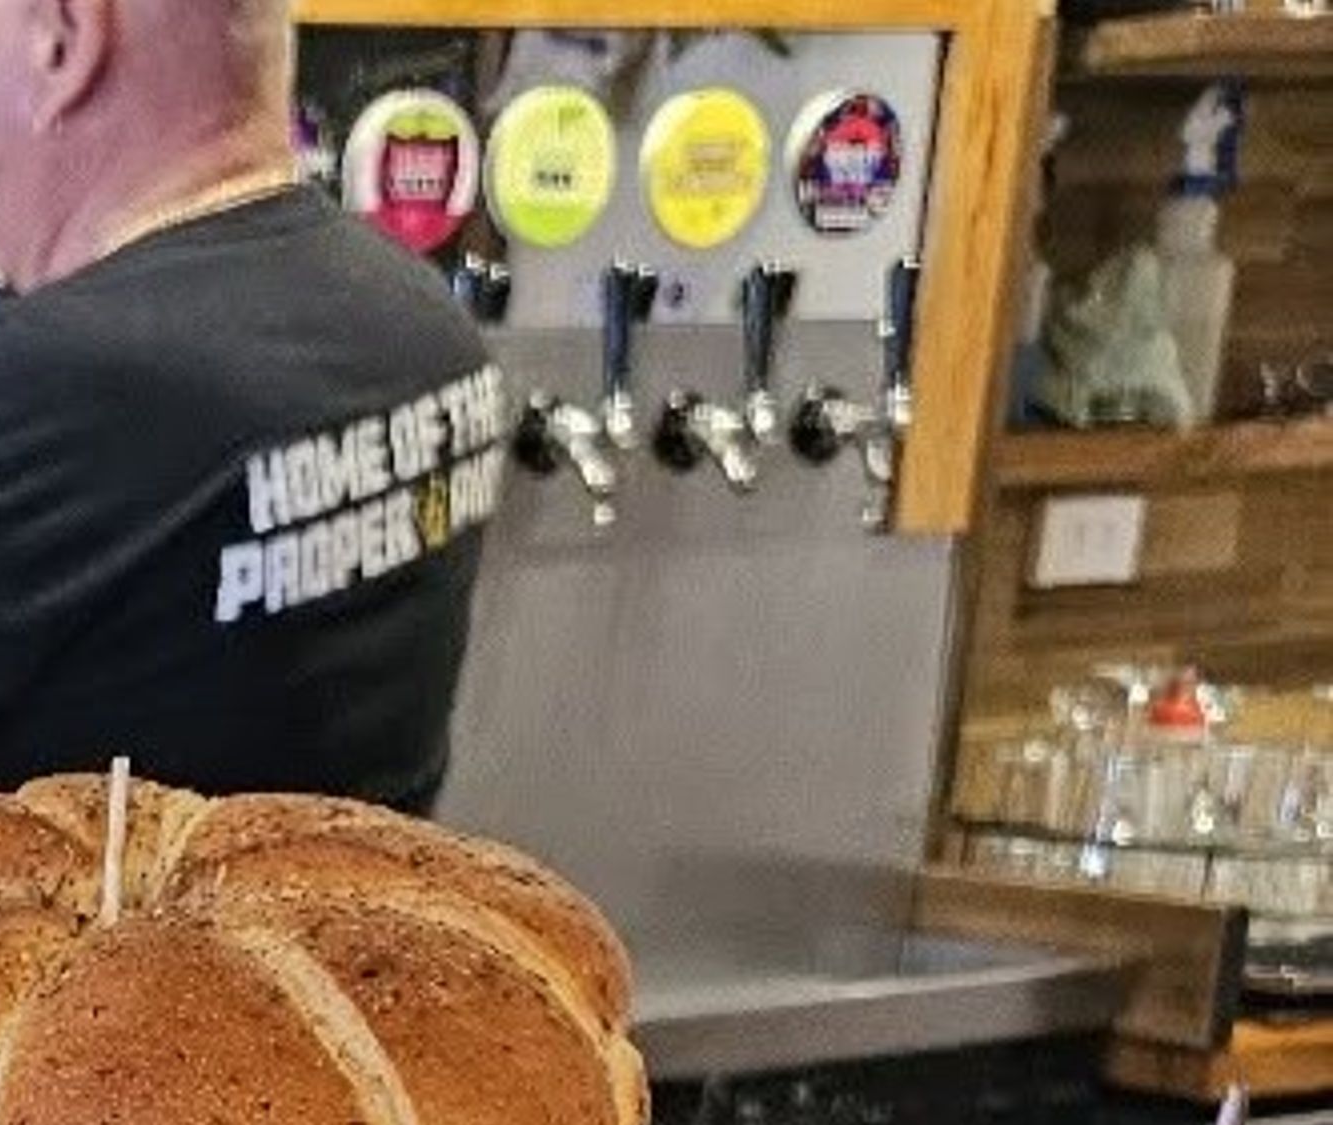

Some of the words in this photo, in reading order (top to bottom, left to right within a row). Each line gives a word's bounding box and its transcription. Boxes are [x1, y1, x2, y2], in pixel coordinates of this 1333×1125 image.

[247, 418, 392, 533] HOME
[390, 395, 446, 482] OF
[215, 489, 422, 621] PROPER
